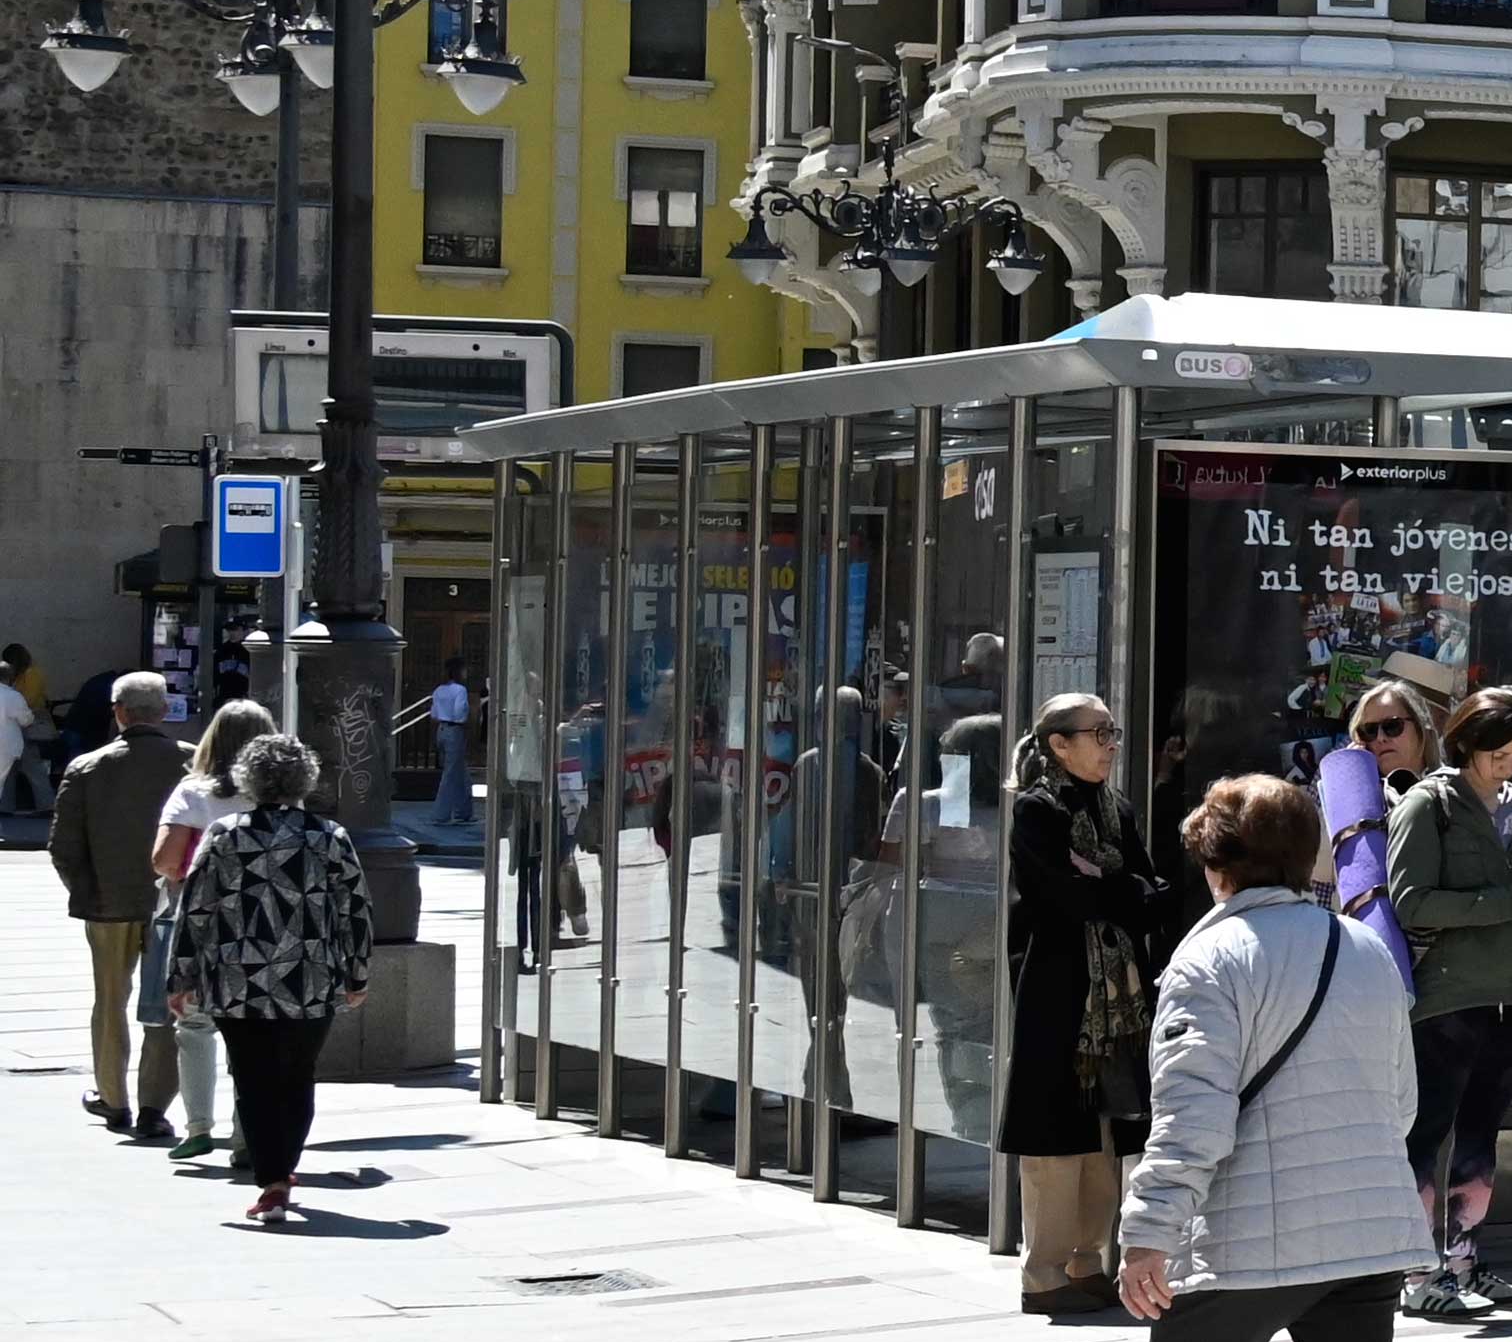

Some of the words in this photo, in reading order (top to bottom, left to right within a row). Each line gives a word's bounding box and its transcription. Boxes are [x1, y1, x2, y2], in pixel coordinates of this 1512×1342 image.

[265, 342, 286, 352] Línea
[379, 346, 407, 356] Destino
[1180, 357, 1223, 373] BUS
[1356, 466, 1447, 481] exteriorplus
[1244, 508, 1292, 548] Ni
[1308, 520, 1374, 549] tan
[1260, 564, 1302, 592] ni
[1319, 570, 1385, 595] tan
[448, 585, 458, 597] 3
